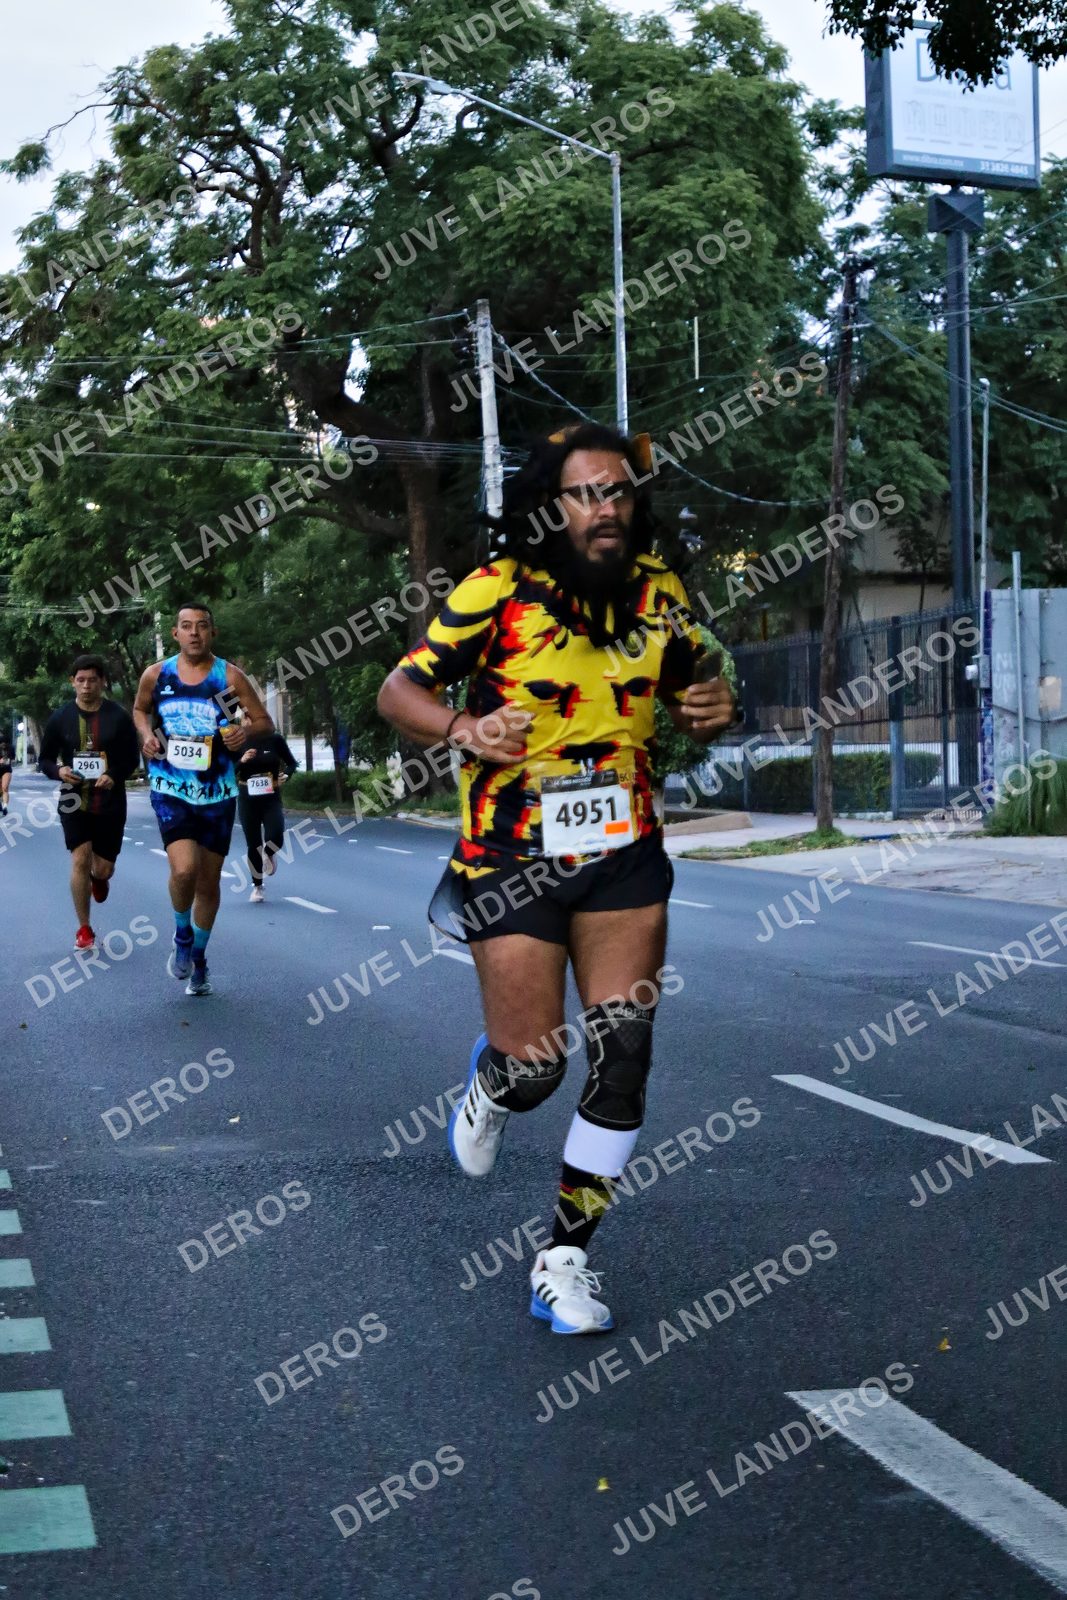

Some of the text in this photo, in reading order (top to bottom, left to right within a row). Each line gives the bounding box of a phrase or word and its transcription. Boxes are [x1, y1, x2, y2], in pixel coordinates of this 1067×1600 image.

[174, 745, 202, 758] 5034
[78, 760, 100, 770] 2961
[251, 779, 268, 788] 7638
[556, 796, 616, 827] 4951
